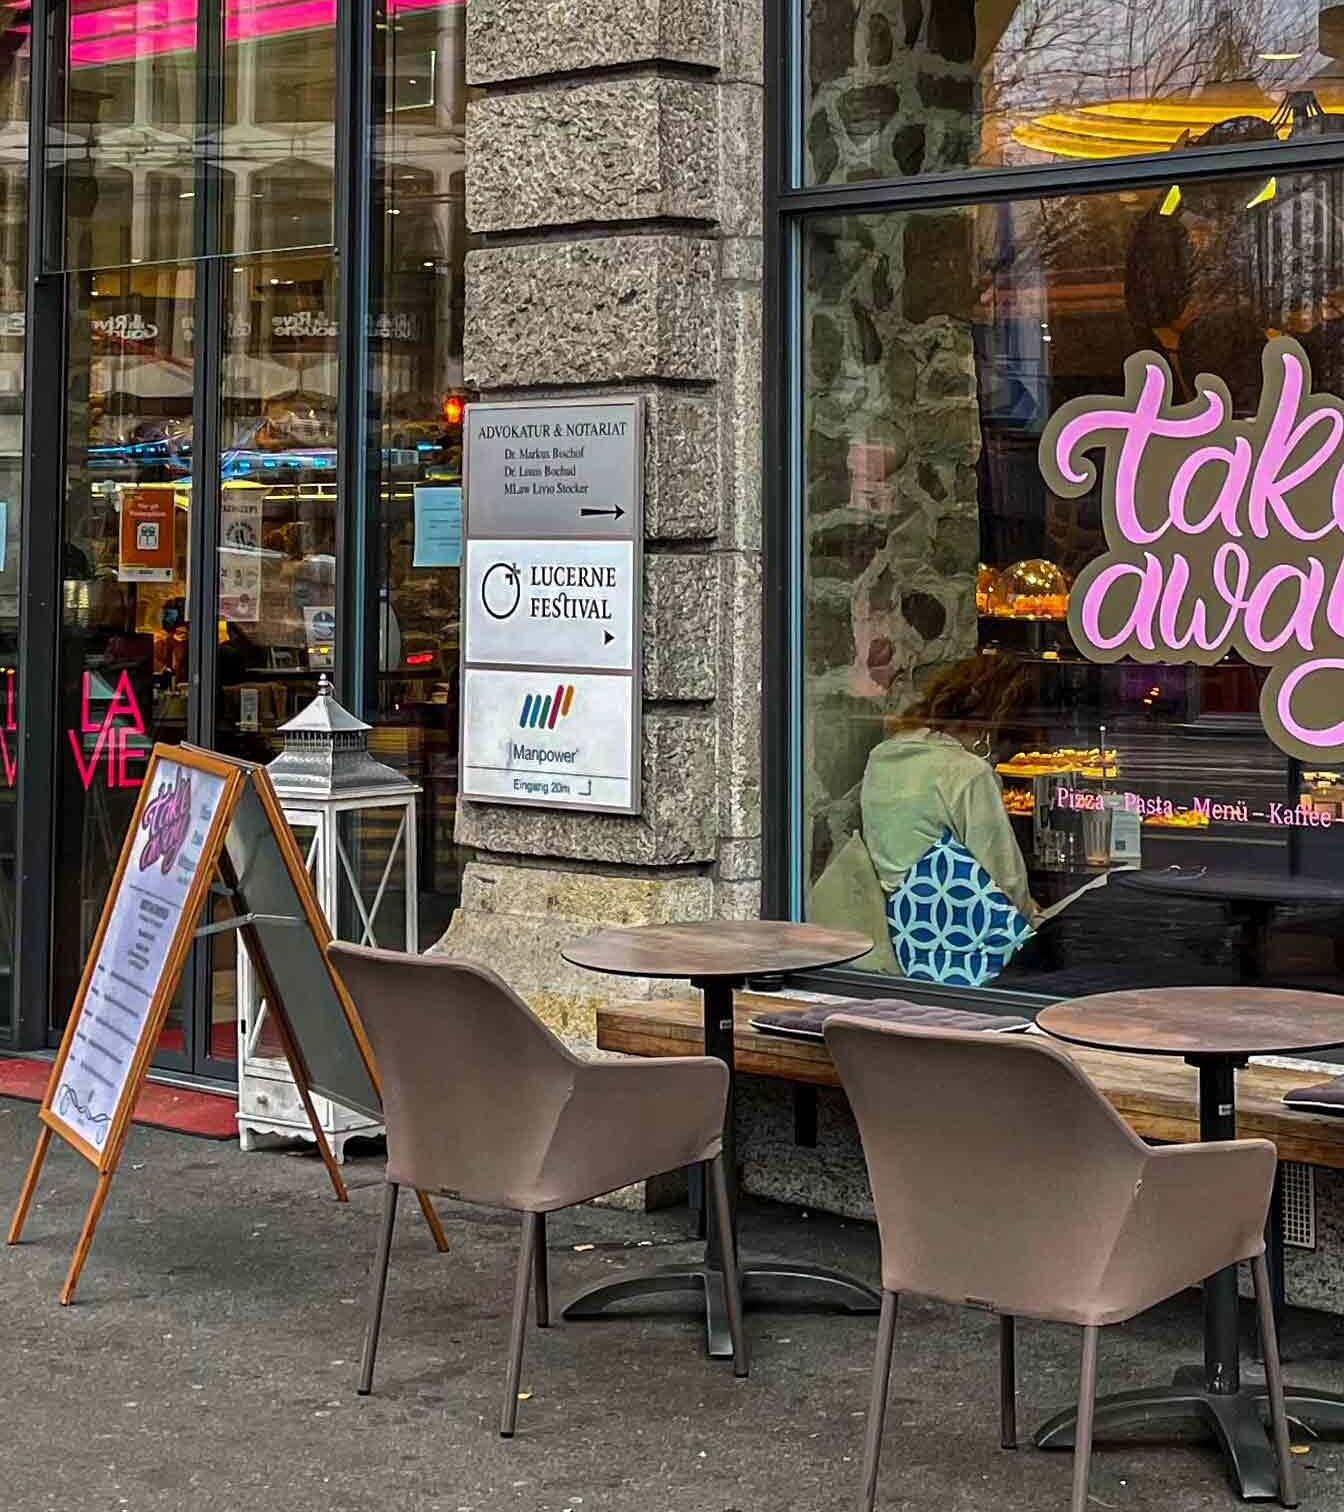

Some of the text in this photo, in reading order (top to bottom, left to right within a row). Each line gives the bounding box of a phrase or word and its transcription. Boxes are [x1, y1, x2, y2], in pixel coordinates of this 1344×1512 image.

[479, 422, 627, 439] ADVOKATUR & NOTARIAT
[531, 566, 616, 588] LUCERNE
[82, 669, 145, 733] LA
[68, 727, 145, 792] VIE
[513, 743, 577, 765] Manpower
[1057, 787, 1105, 811] Pizza
[1125, 791, 1173, 817] Pasta
[1193, 796, 1248, 823] Menü
[1270, 801, 1332, 829] Kaffee
